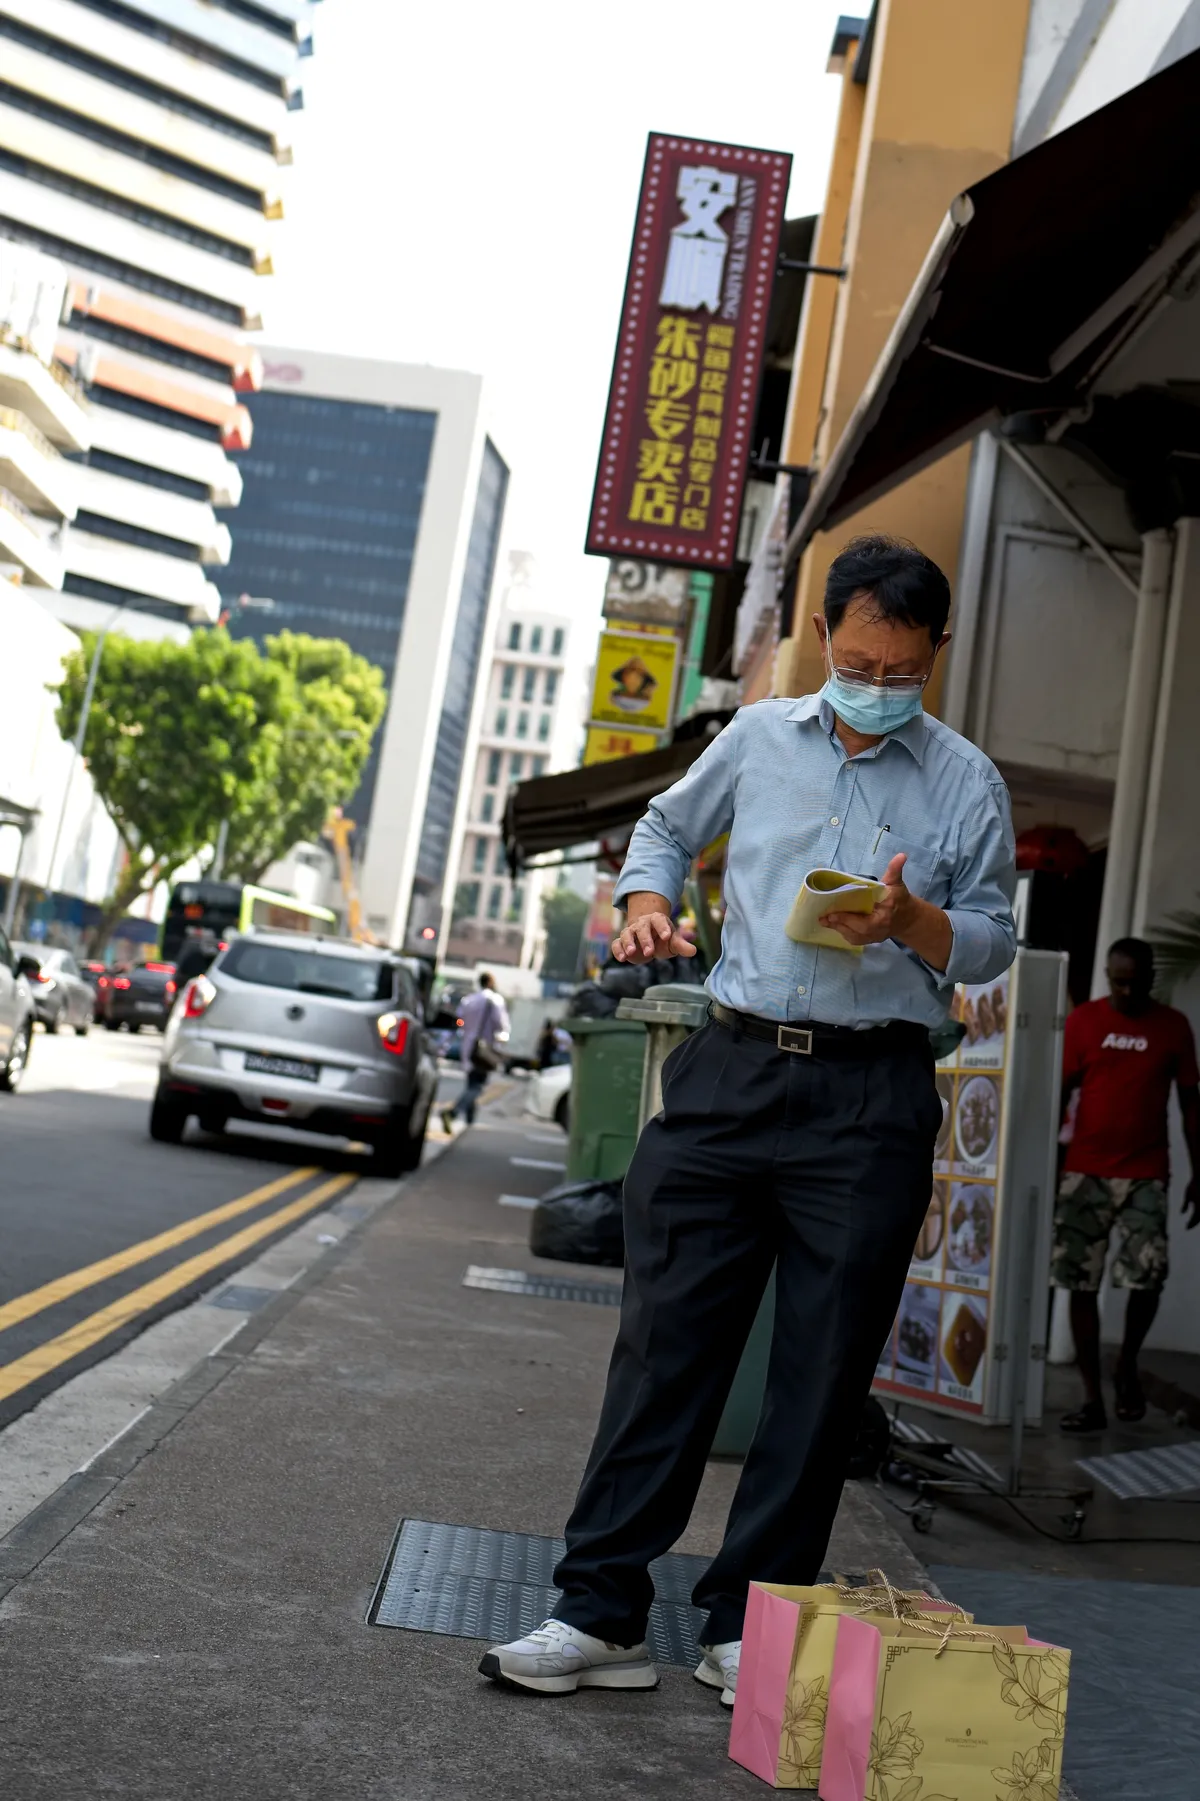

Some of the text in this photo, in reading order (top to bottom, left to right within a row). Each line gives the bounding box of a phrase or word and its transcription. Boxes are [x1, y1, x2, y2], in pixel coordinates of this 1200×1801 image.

[721, 252, 747, 320] TRADING
[627, 315, 702, 526] 朱砂专卖店
[1101, 1032, 1148, 1052] Aero
